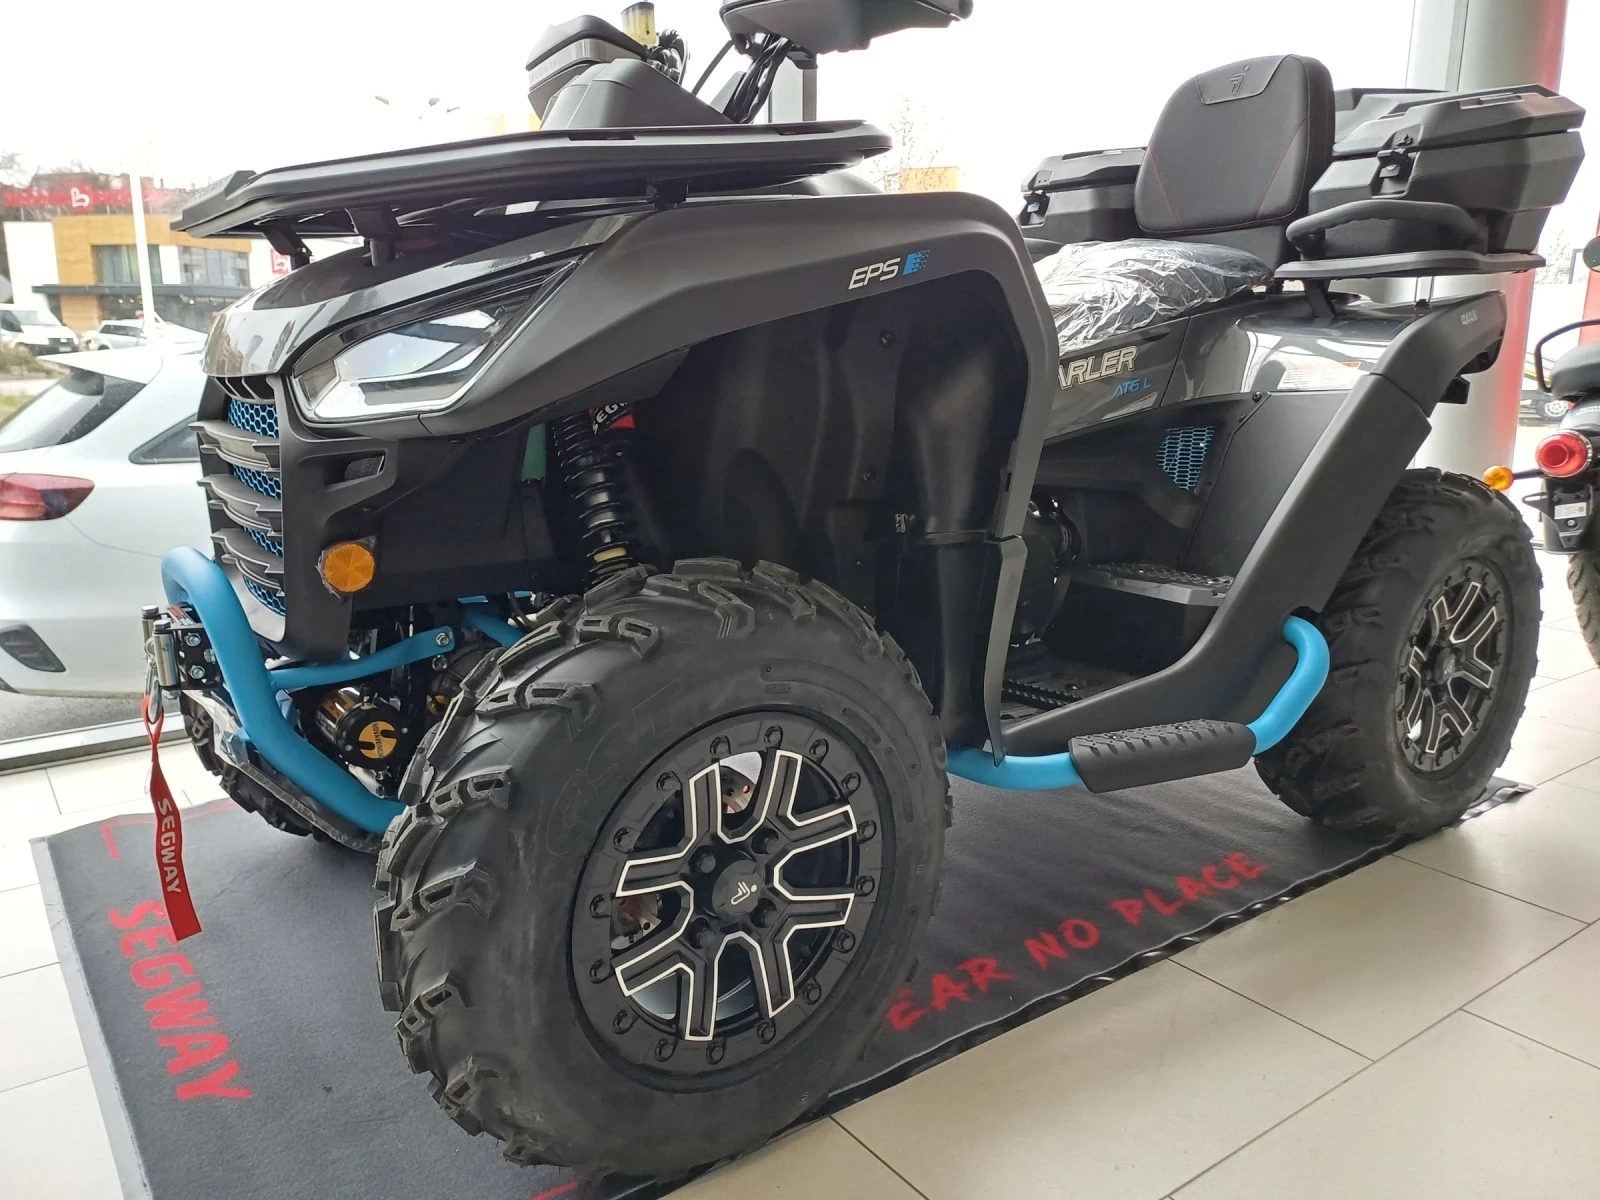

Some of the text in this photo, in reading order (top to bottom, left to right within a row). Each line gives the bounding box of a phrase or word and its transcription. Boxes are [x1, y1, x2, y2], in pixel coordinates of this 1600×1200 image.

[848, 257, 902, 291] EPS
[592, 402, 628, 435] SEG
[158, 797, 182, 893] SEGWAY
[1024, 917, 1099, 969] NO
[1105, 851, 1268, 926] PLACE
[109, 900, 253, 1101] SEGWAY
